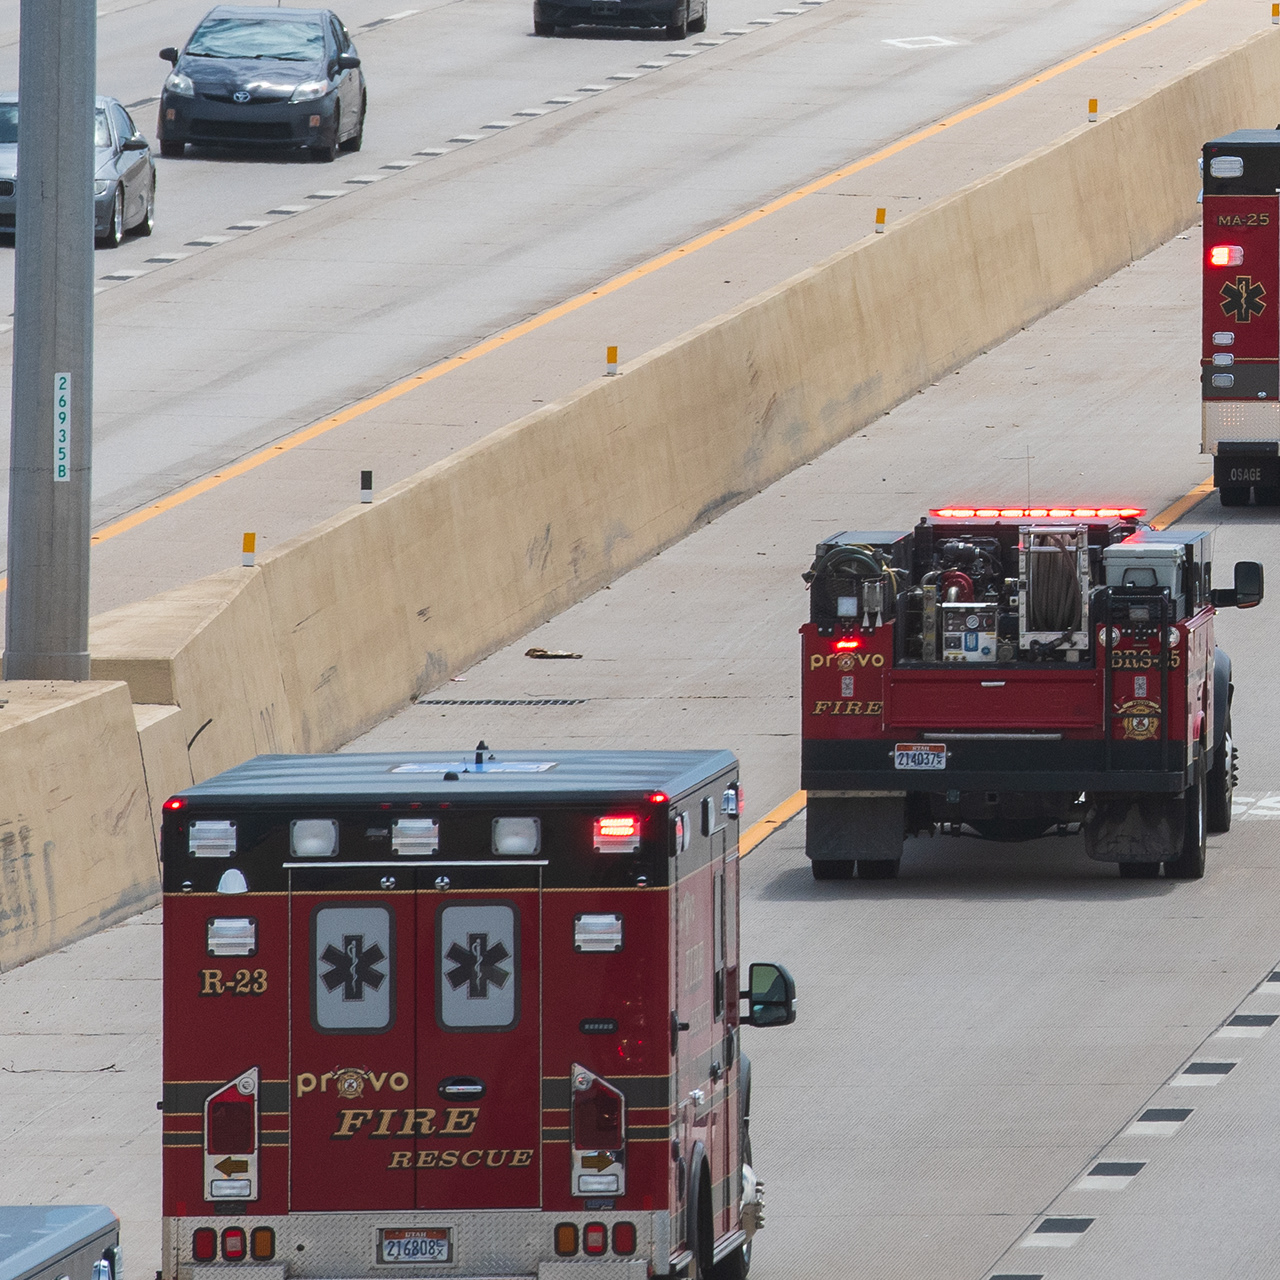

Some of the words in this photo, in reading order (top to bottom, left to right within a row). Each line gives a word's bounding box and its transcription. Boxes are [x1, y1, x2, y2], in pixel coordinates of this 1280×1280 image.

[1218, 213, 1270, 226] MA-25
[58, 376, 67, 478] 26935B
[1230, 468, 1260, 480] OSAGE
[1111, 649, 1181, 669] BRS-5
[812, 701, 884, 714] FIRE
[201, 969, 268, 995] R-23
[333, 1108, 480, 1139] FIRE
[388, 1150, 534, 1170] RESCUE
